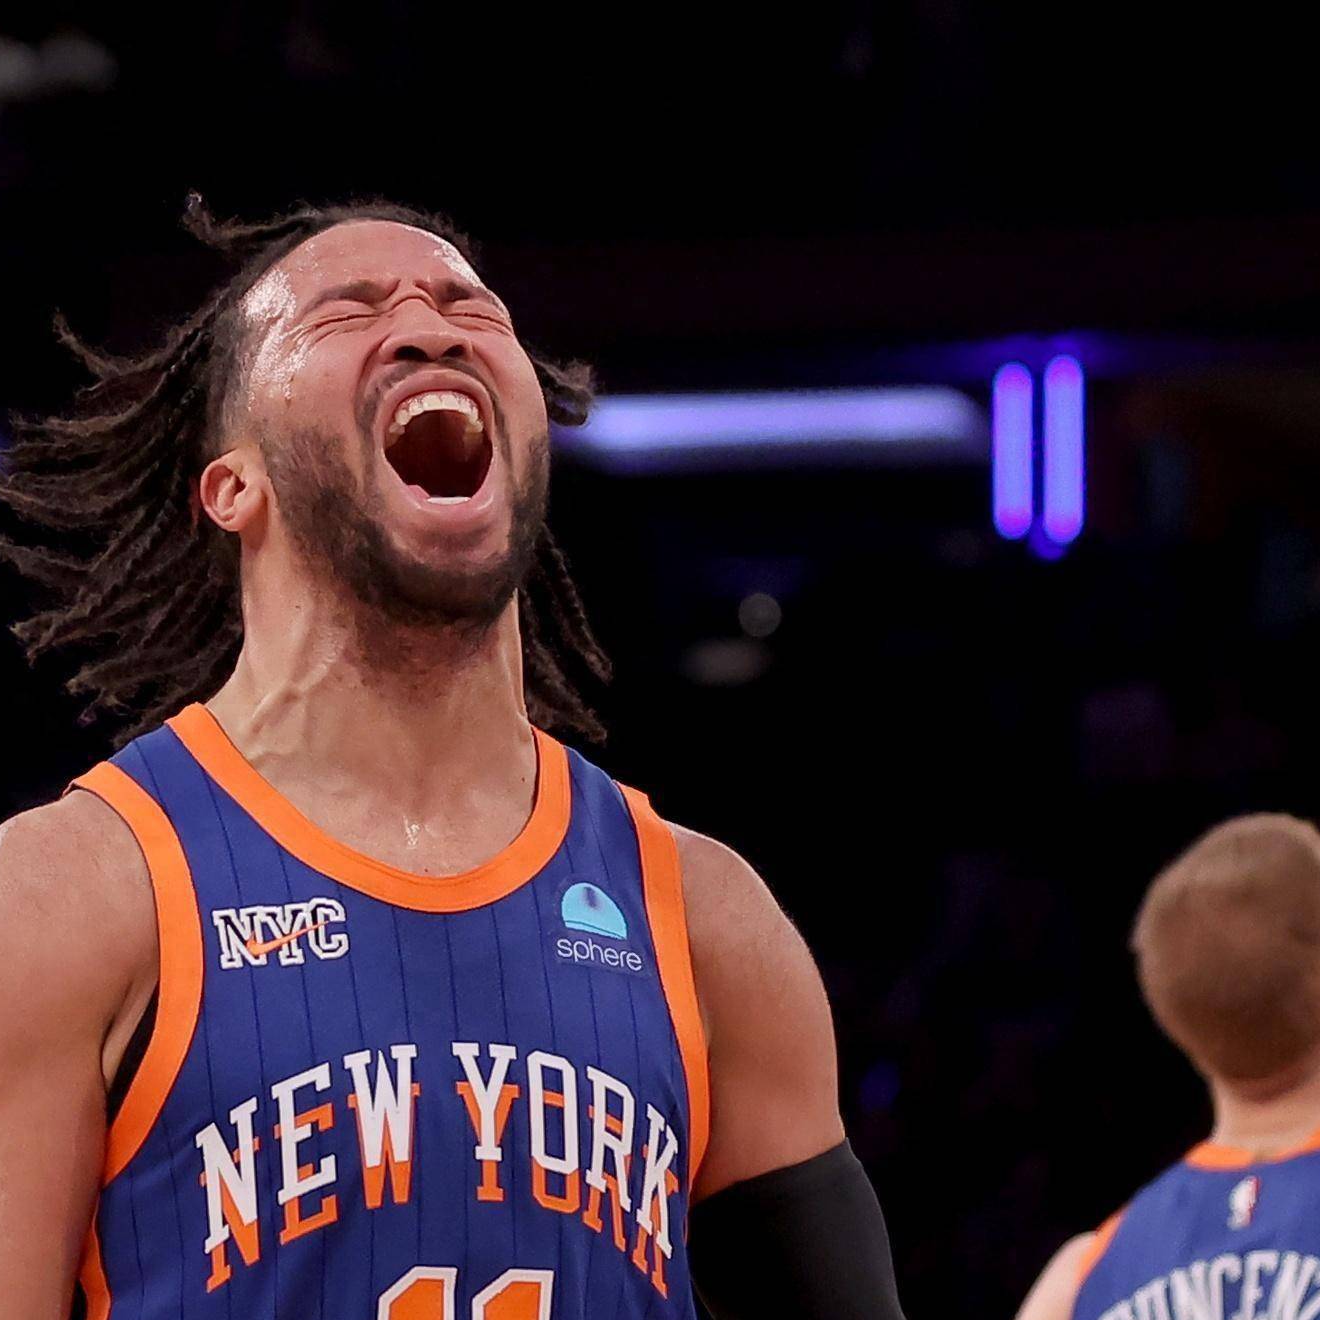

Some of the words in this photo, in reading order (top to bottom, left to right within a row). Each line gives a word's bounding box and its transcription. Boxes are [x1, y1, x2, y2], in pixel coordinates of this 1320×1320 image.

[212, 898, 349, 969] NYC
[556, 937, 643, 972] sphere
[195, 1043, 420, 1275] NEW
[451, 1041, 679, 1280] YORK
